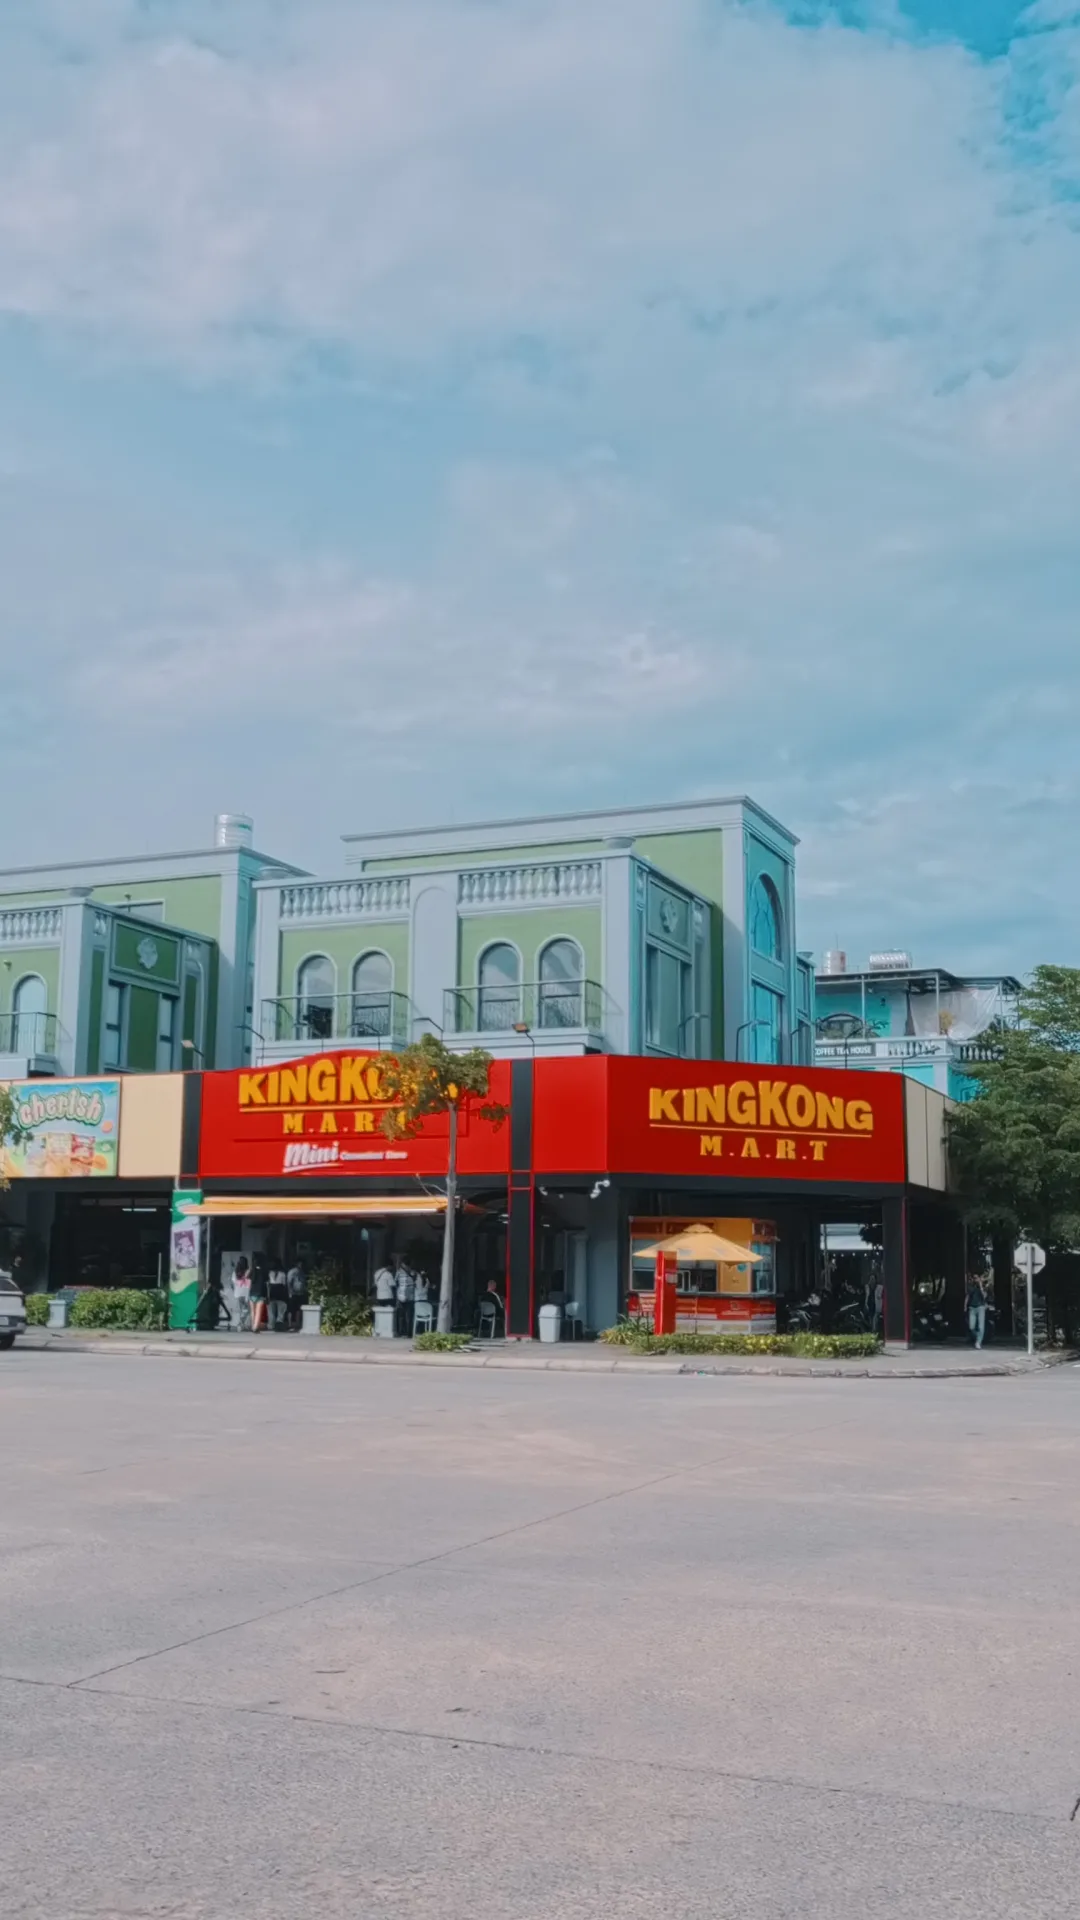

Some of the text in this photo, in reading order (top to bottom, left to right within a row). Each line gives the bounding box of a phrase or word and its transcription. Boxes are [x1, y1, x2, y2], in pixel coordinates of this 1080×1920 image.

[850, 1044, 872, 1054] HOUSE
[20, 1086, 103, 1126] cherish
[649, 1080, 874, 1130] KINGKONG
[284, 1140, 339, 1168] Mini
[700, 1135, 827, 1161] M.A.R.T
